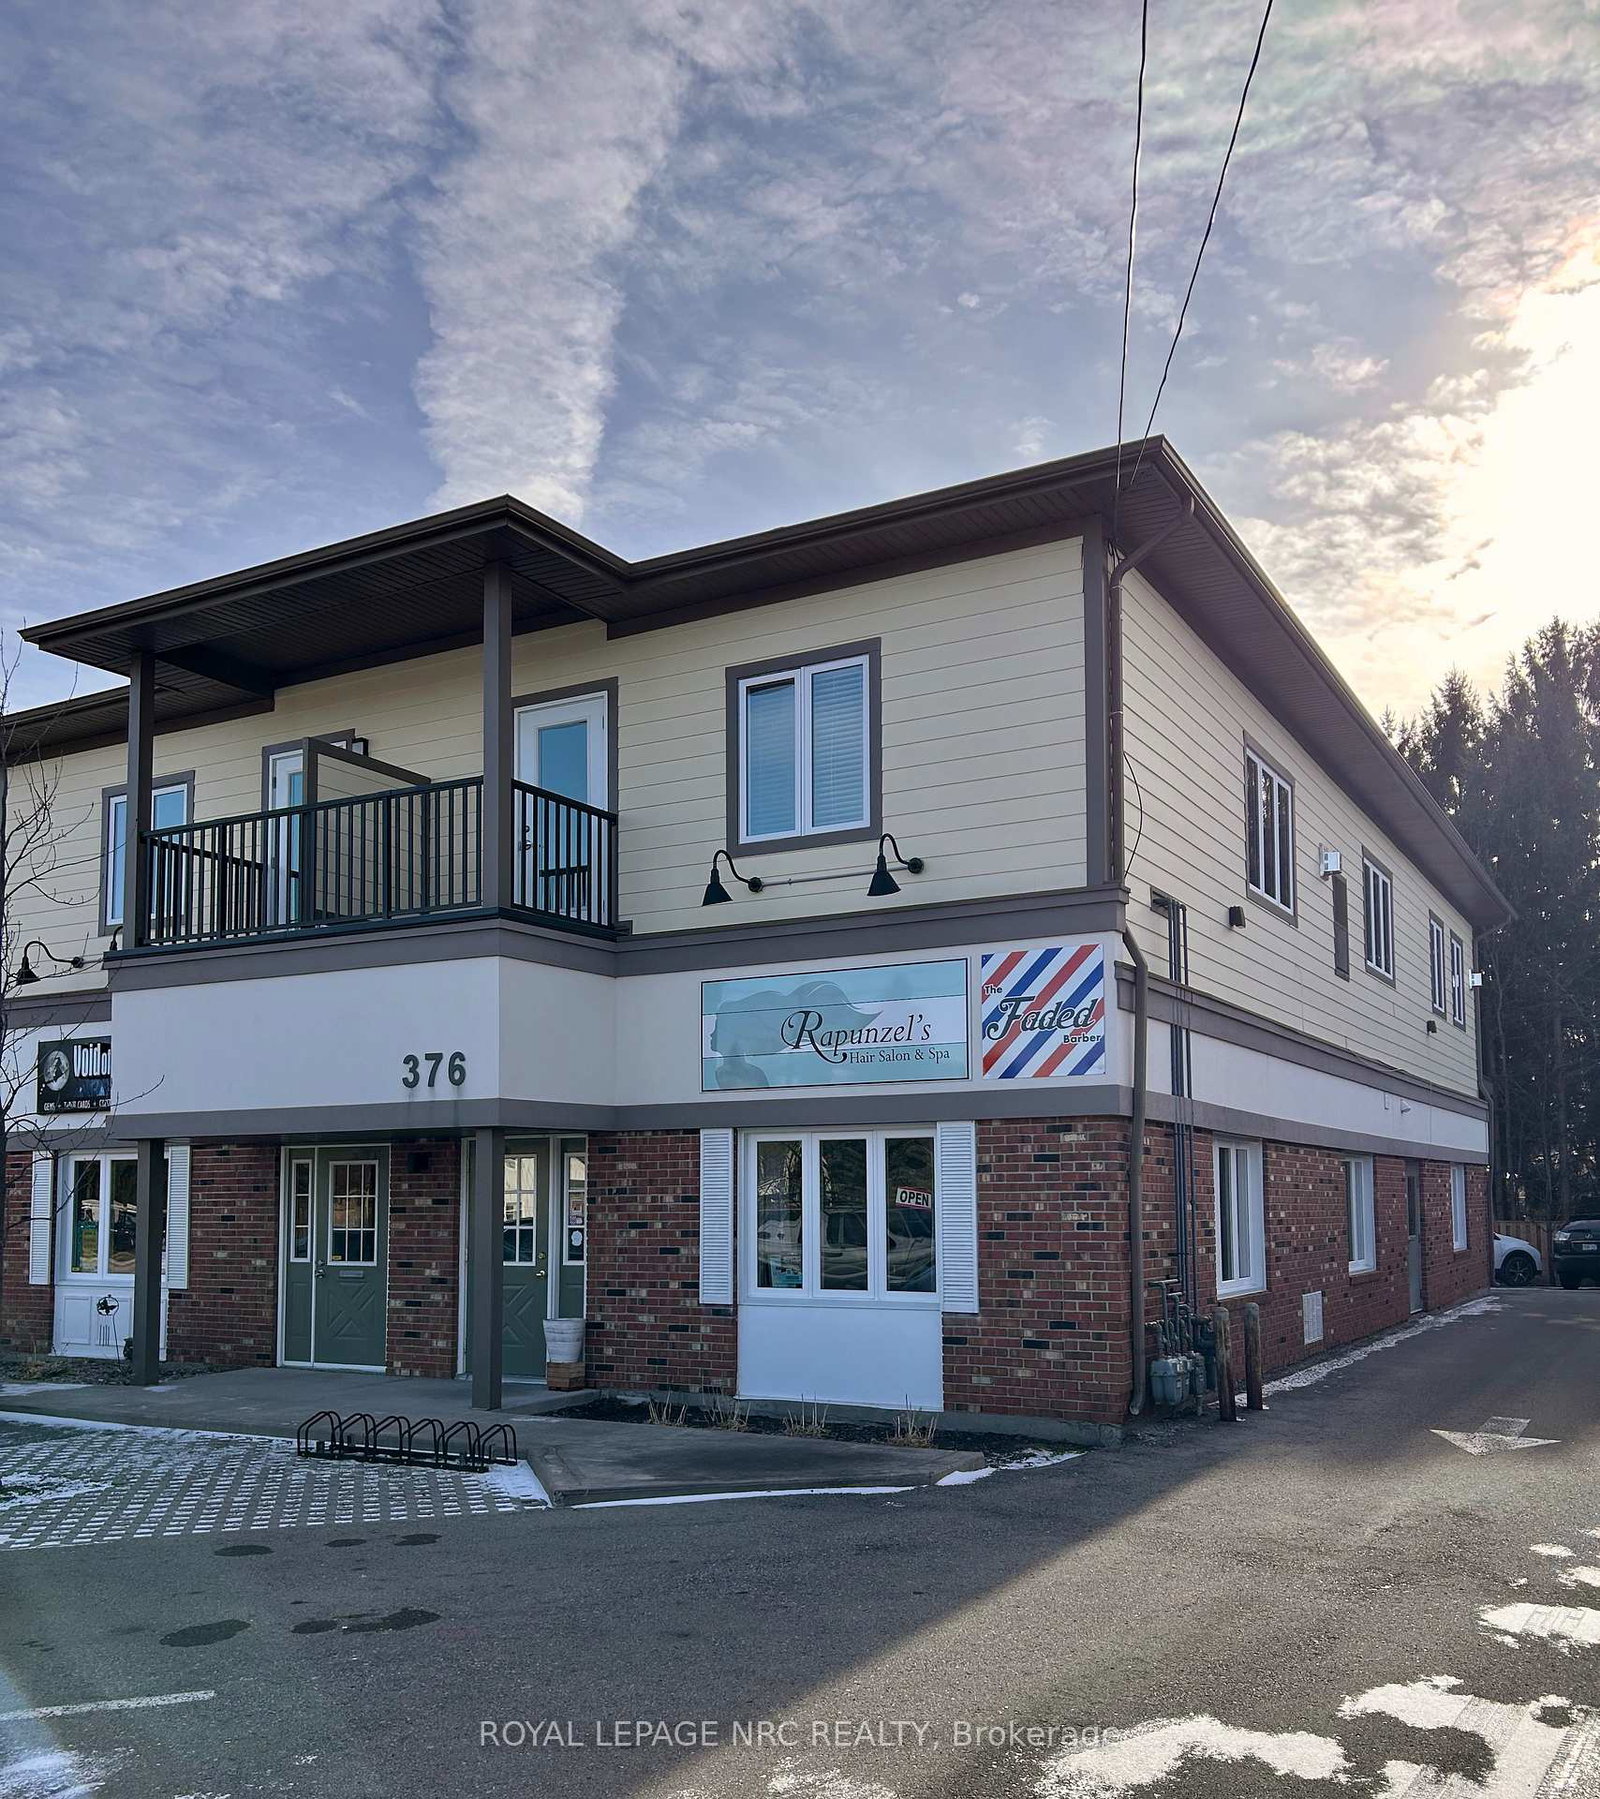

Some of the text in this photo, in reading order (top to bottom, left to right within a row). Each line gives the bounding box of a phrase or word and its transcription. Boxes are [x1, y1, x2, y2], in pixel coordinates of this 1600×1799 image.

[984, 985, 1003, 994] The
[986, 995, 1098, 1040] Faded
[781, 1010, 931, 1064] Rapunzel's
[1063, 1033, 1101, 1044] Barber
[73, 1043, 101, 1077] Void
[849, 1047, 950, 1064] Hair Salon & Spa
[402, 1051, 466, 1088] 376
[900, 1190, 929, 1206] OPEN
